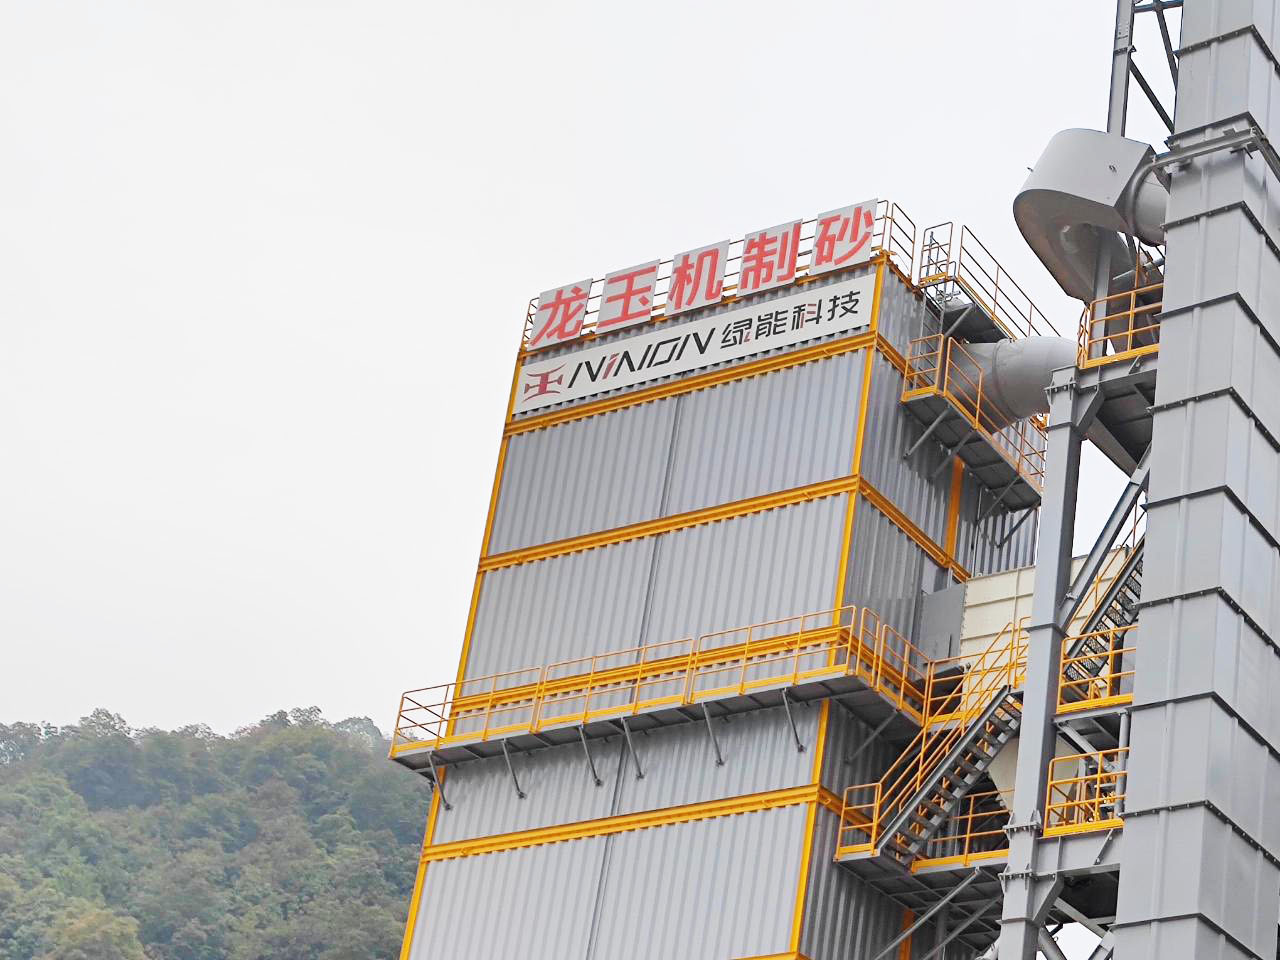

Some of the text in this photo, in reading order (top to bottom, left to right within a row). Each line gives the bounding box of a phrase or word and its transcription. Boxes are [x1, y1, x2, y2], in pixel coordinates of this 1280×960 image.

[529, 207, 874, 346] 龙玉机制砂
[720, 290, 861, 346] 绿能科技
